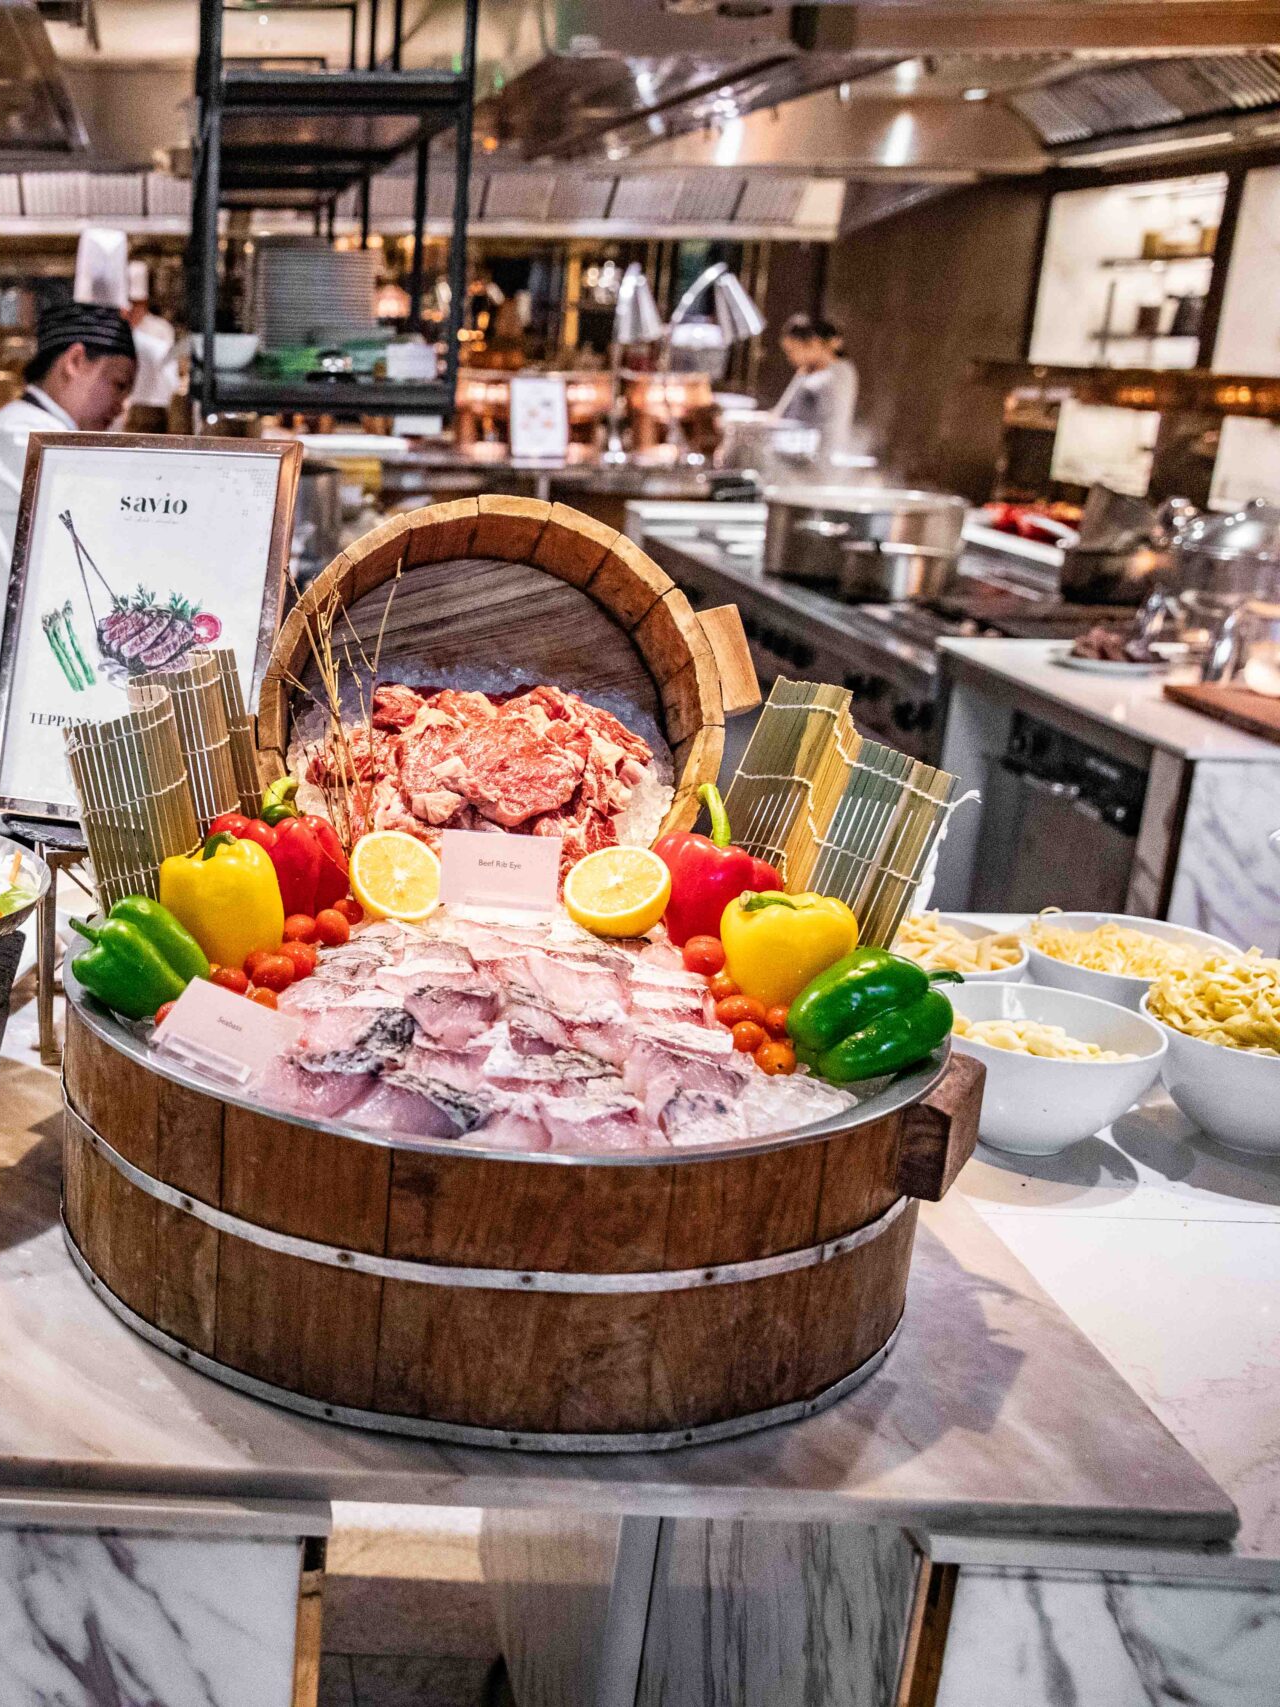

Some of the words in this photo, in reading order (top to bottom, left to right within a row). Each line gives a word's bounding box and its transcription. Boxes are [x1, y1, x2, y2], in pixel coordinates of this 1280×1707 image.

[120, 492, 188, 515] savio
[29, 711, 102, 727] TEPPAN
[478, 858, 494, 867] Beef
[496, 860, 508, 868] Rib
[509, 861, 522, 870] Eye
